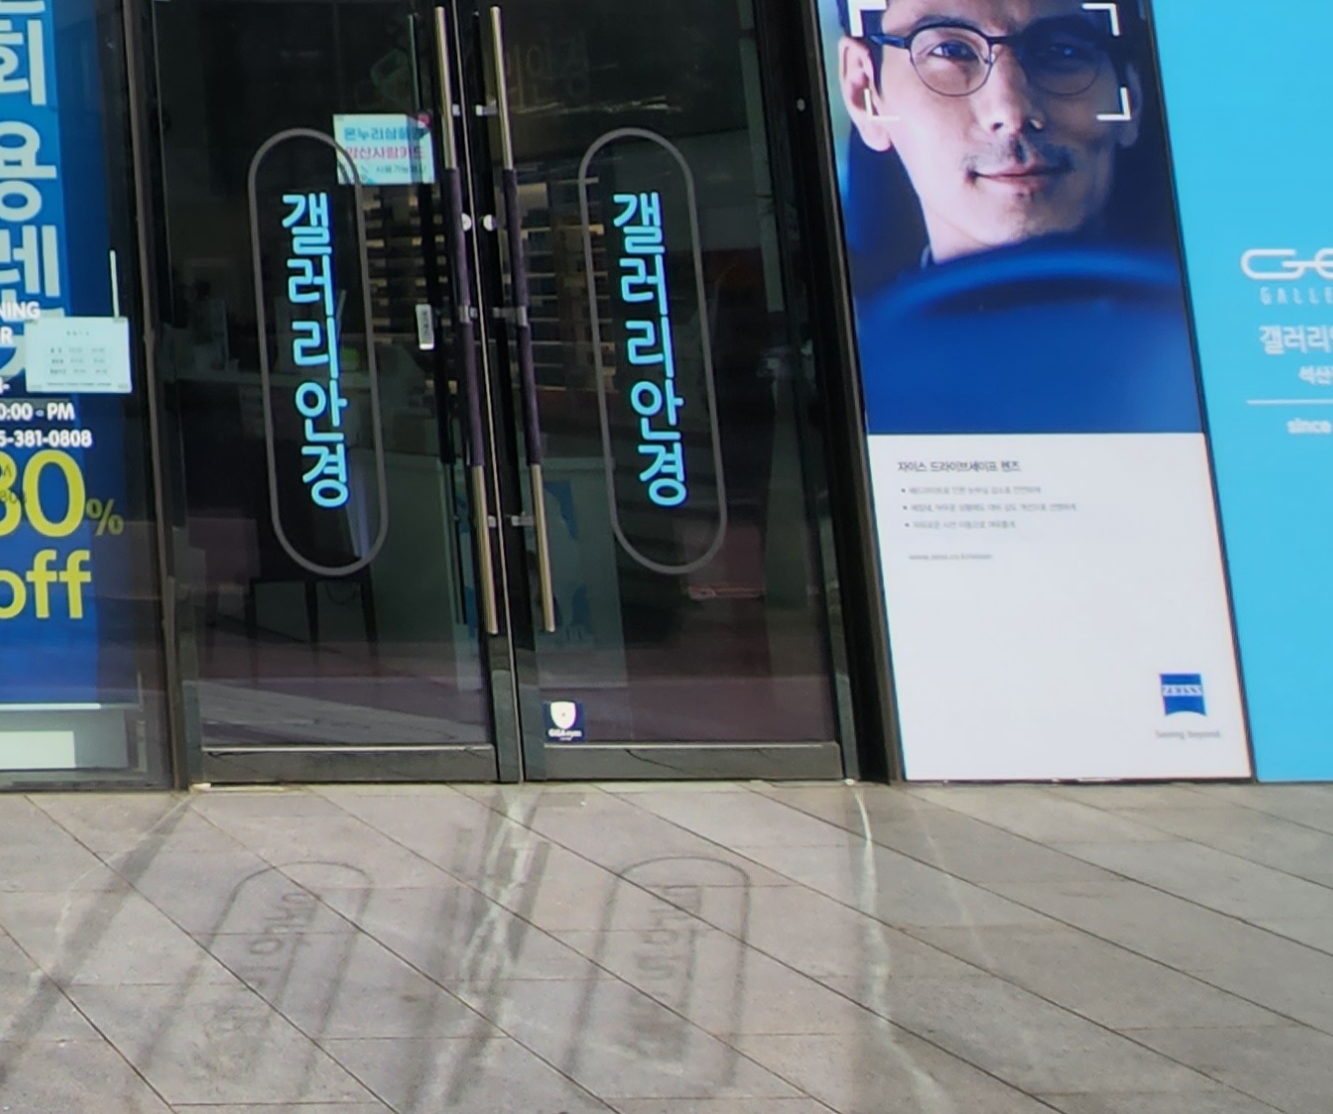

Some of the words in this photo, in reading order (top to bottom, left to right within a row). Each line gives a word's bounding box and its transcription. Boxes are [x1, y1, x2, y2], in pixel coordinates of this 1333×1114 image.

[46, 402, 76, 421] PM
[282, 191, 351, 509] 갤러리안경
[613, 191, 688, 509] 갤러리안경
[1259, 324, 1333, 355] 갤러리
